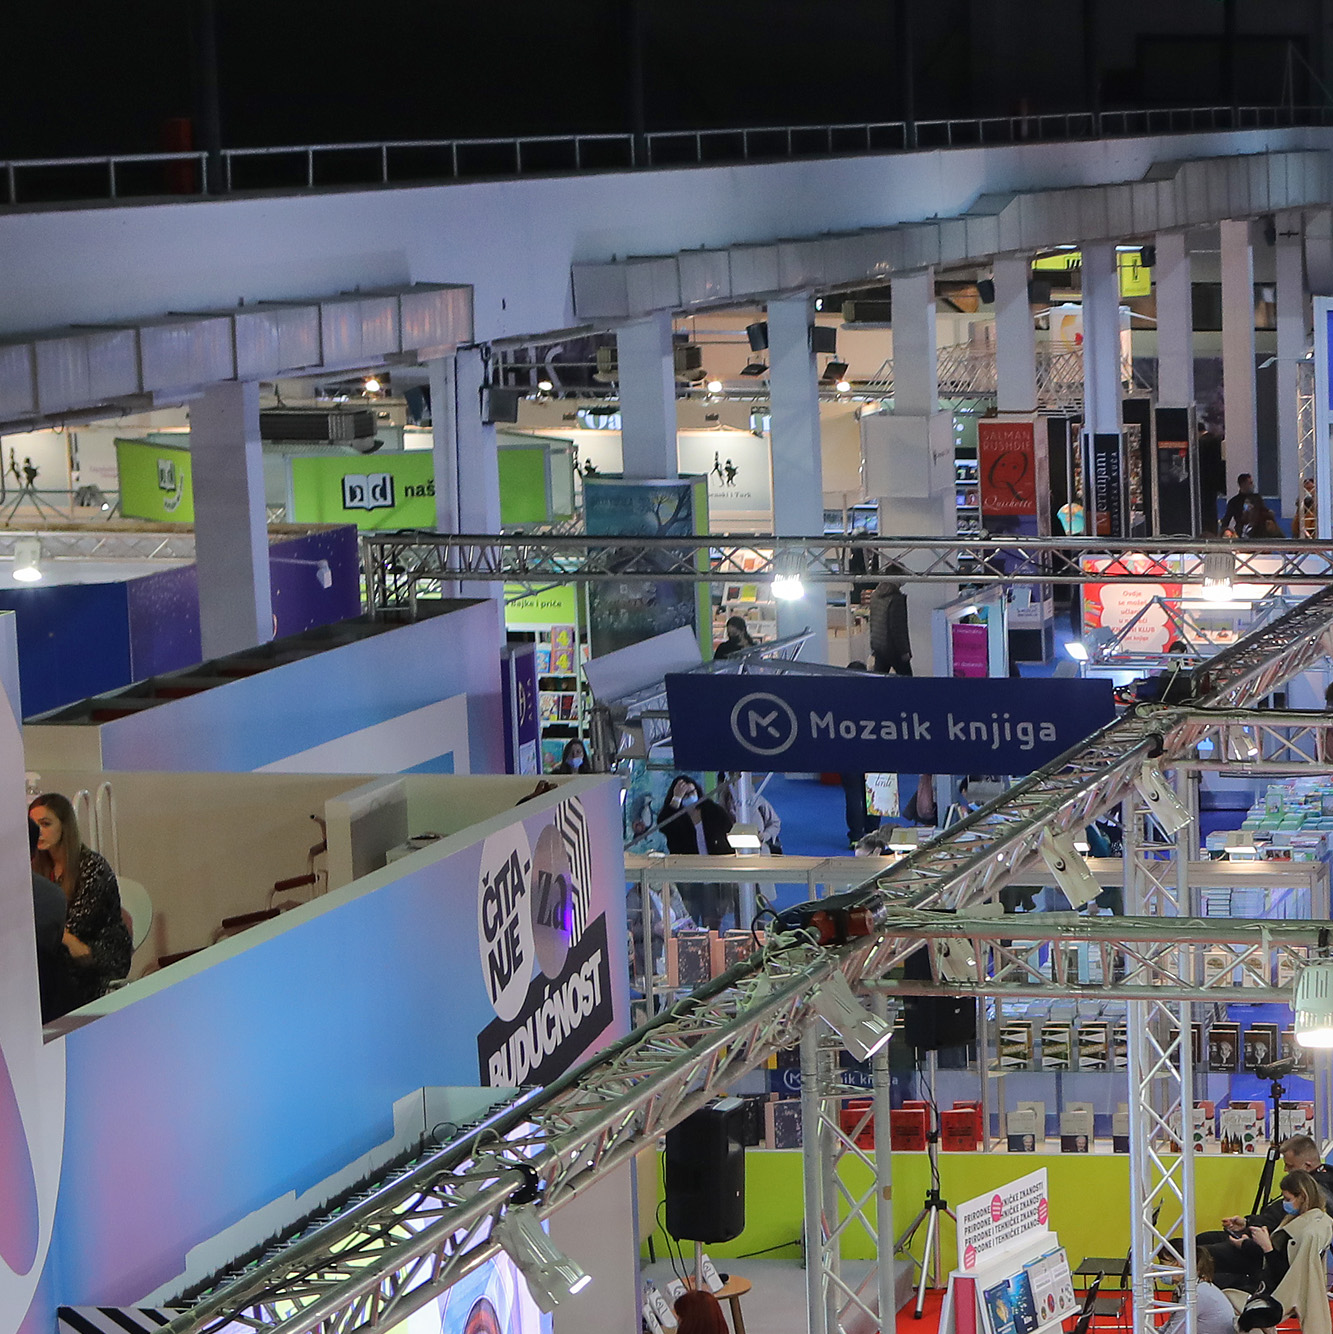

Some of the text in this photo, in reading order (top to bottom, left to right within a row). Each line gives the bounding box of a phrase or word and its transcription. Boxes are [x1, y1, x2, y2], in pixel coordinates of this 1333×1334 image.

[982, 430, 1031, 441] SALMAN
[809, 711, 1057, 750] Mozaik knjiga
[481, 855, 533, 946] ČITA-
[536, 869, 568, 932] za
[488, 917, 524, 1006] NJE
[487, 956, 604, 1090] BUDUĆNOST
[963, 1181, 1044, 1225] PRIRODNE ZNANOSTI
[964, 1217, 991, 1236] PRIRODNE
[995, 1215, 1020, 1234] TEHNIČKE
[996, 1226, 1020, 1246] TEHNIČKE
